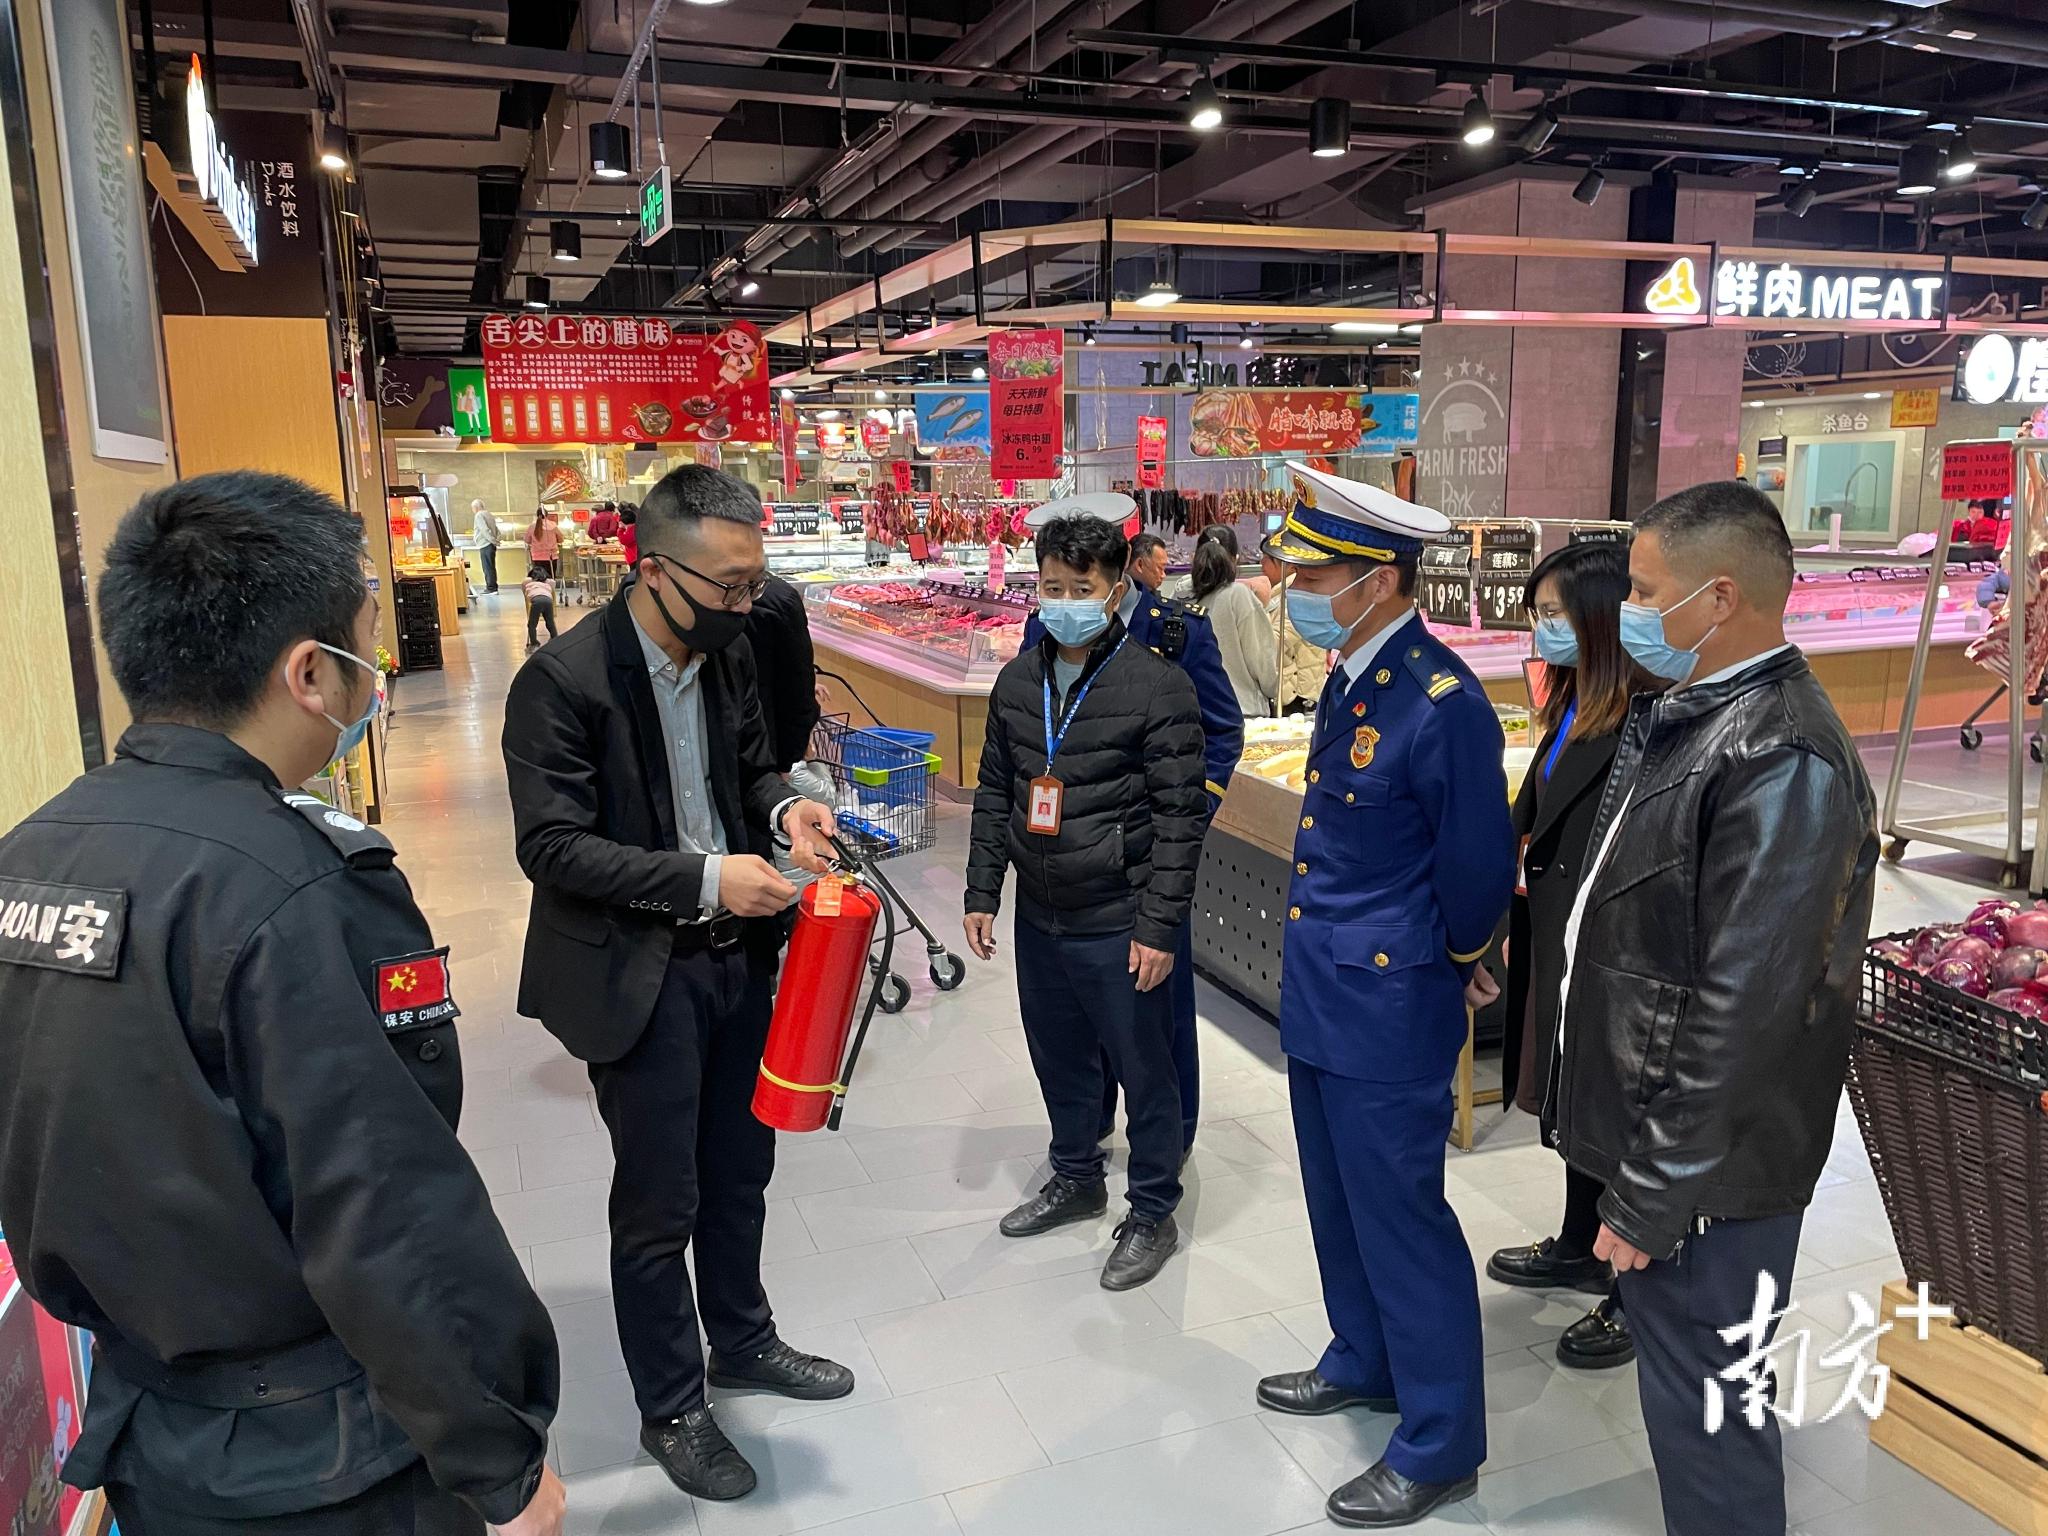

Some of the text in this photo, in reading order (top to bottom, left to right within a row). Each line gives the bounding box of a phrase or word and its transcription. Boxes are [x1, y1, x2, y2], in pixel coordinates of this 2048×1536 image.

[261, 161, 277, 207] Drinks
[277, 162, 300, 237] 酒水饮料
[1716, 260, 1943, 320] 鲜肉 MEAT
[485, 318, 668, 346] 舌尖上的腊味
[1007, 387, 1048, 400] 天天新鲜
[1003, 404, 1044, 416] 每日特惠
[1268, 404, 1356, 433] 腊味飘香
[1822, 412, 1869, 434] 杀鱼台
[1416, 445, 1508, 478] FARM FRESH
[1428, 583, 1463, 613] 19.90
[0, 898, 110, 963] AOAN 安
[385, 1010, 414, 1028] 保安
